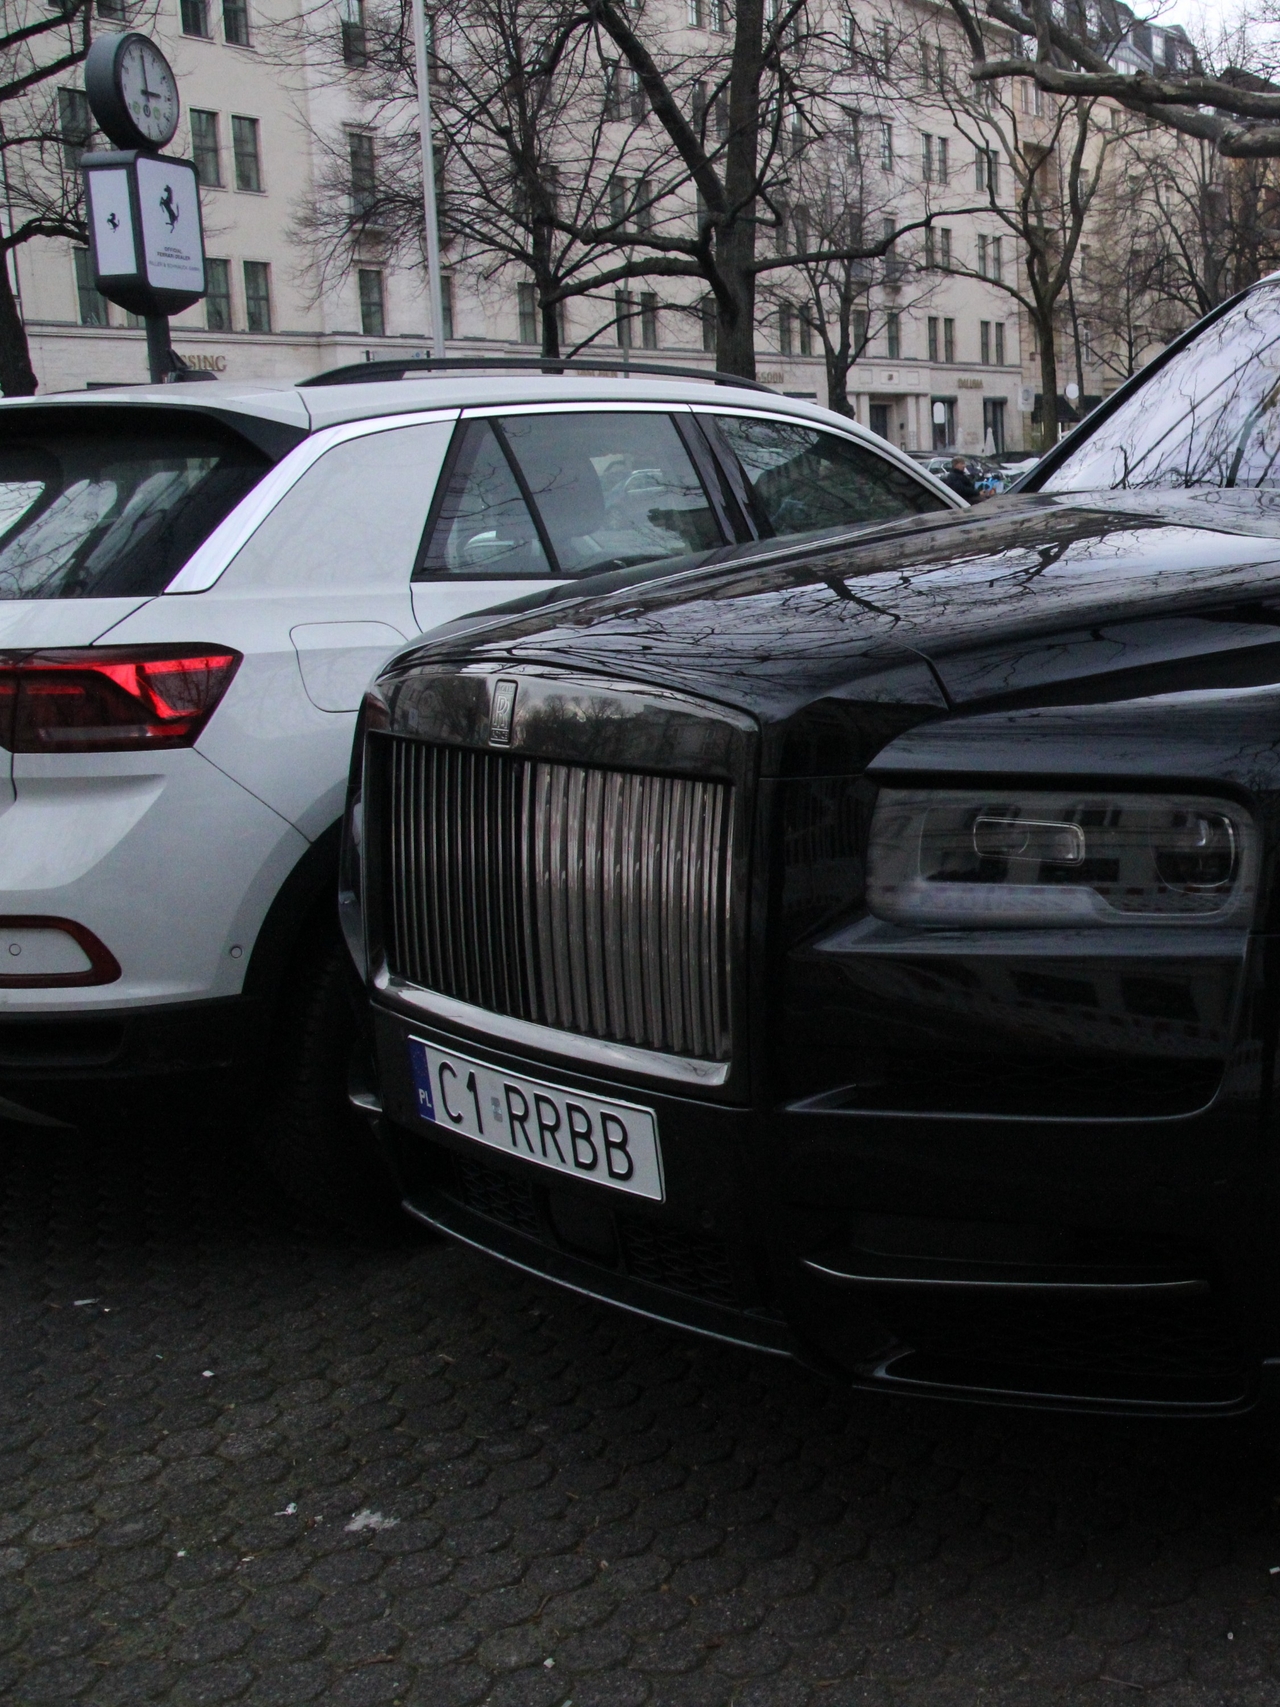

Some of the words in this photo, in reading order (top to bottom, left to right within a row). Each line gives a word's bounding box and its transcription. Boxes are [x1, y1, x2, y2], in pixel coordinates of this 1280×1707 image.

[418, 1087, 433, 1109] PL
[438, 1060, 485, 1136] C1
[503, 1080, 635, 1182] RRBB
